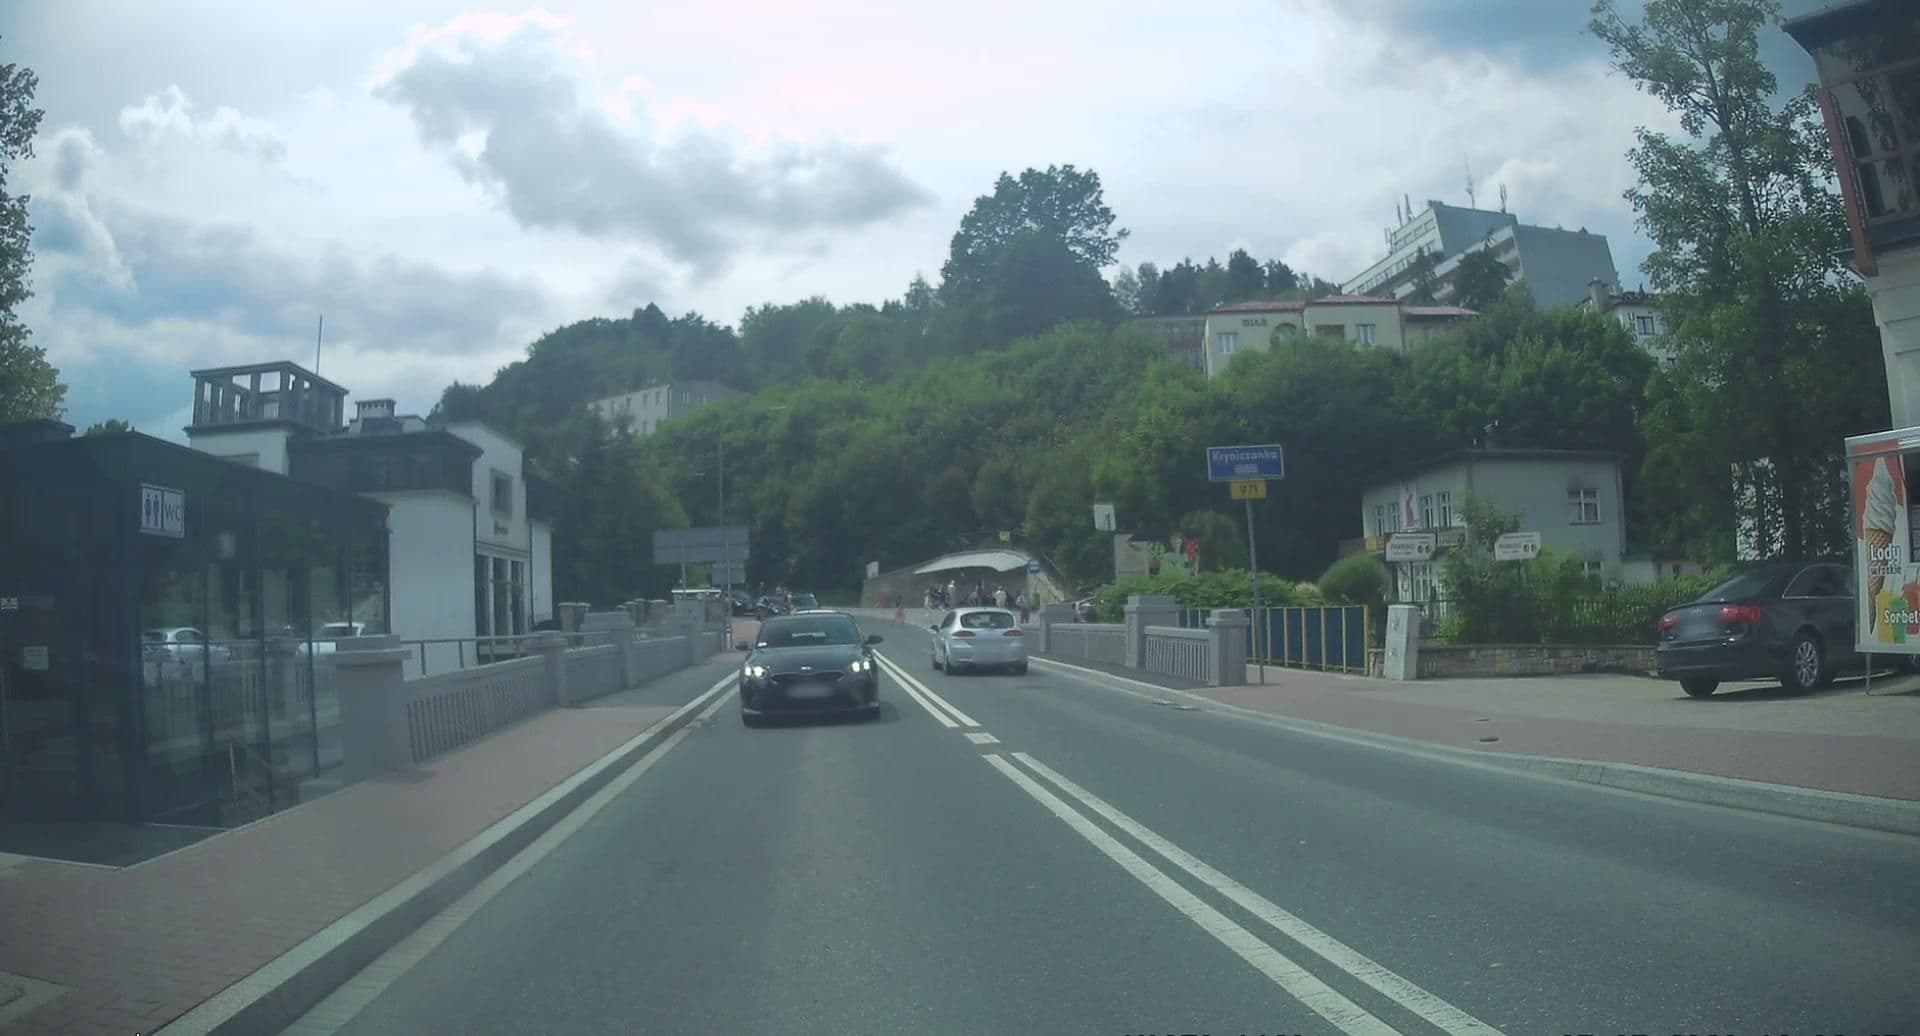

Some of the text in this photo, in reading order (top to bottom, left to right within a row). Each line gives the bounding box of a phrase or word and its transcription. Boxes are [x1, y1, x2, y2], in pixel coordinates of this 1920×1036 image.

[1212, 449, 1278, 464] Kryniczanka
[1239, 484, 1258, 497] 971
[164, 503, 182, 521] WC
[1870, 543, 1901, 566] Lody
